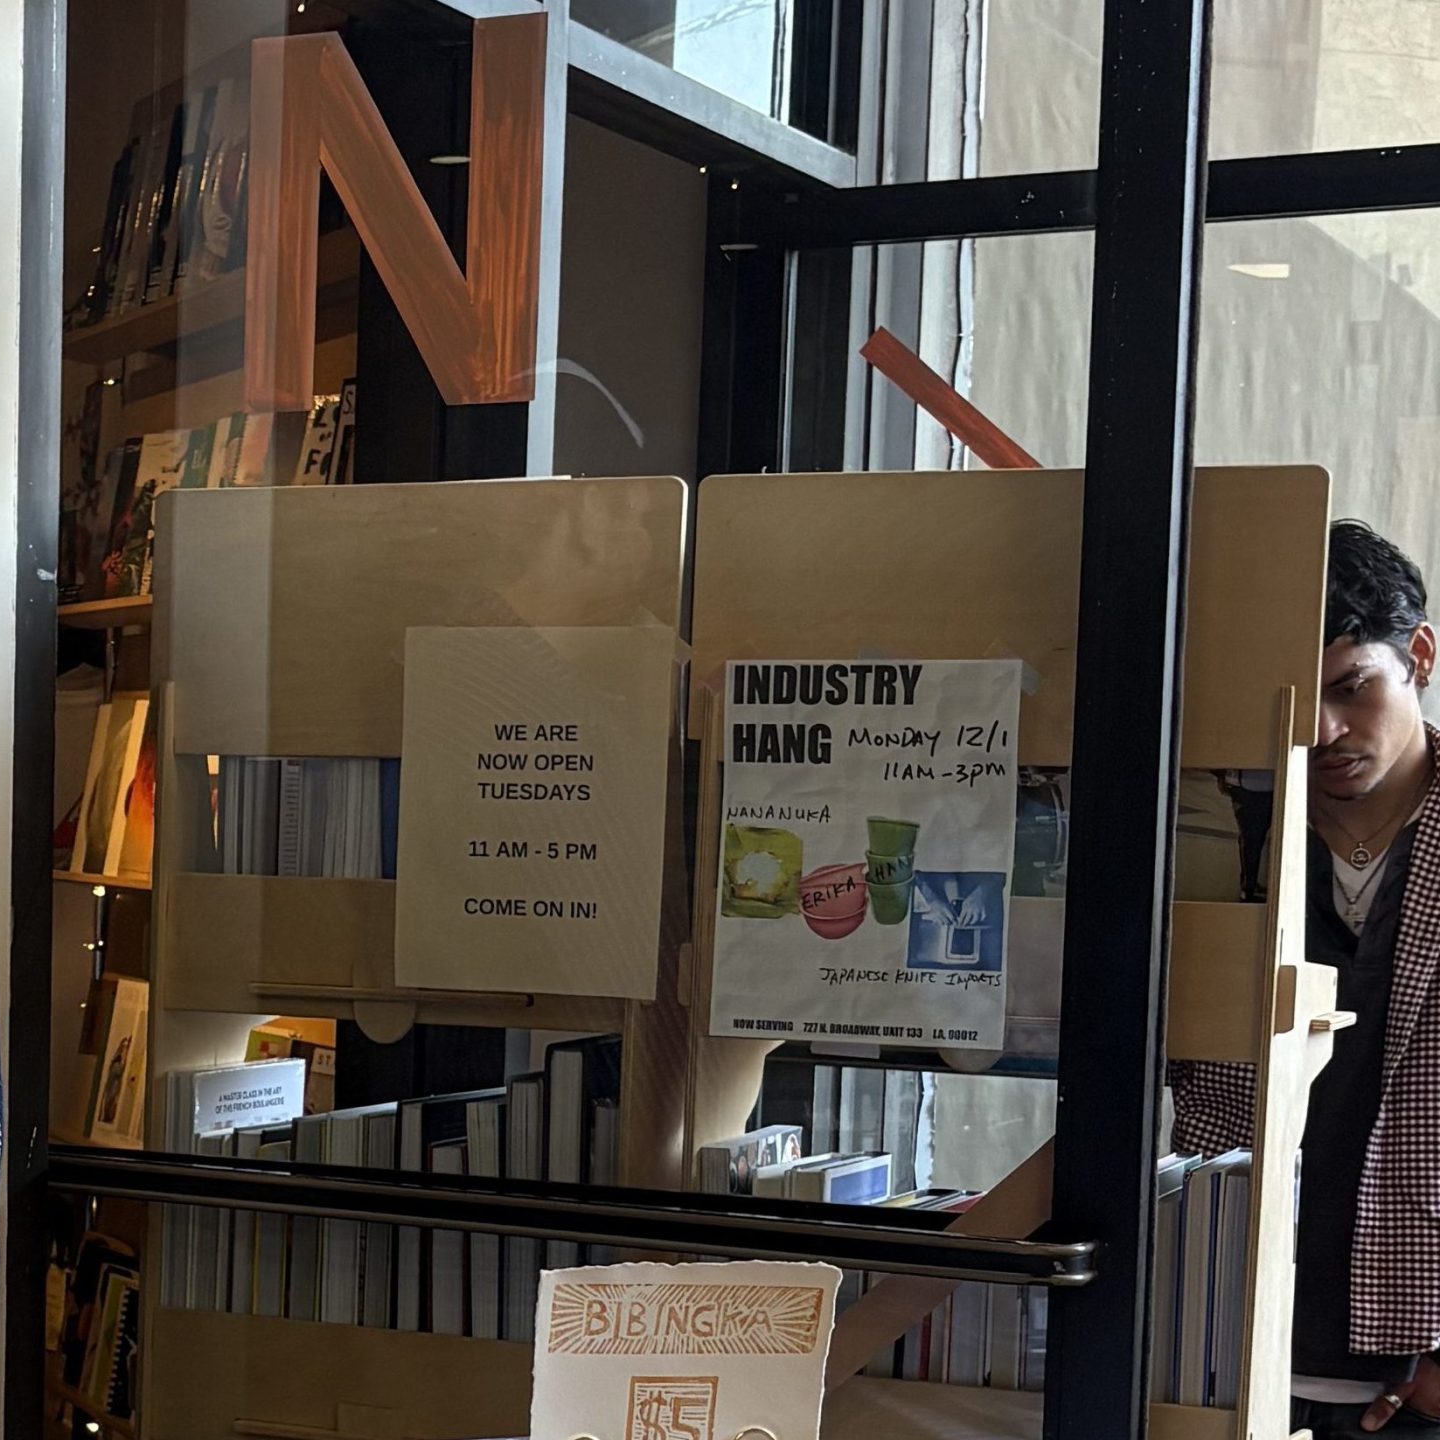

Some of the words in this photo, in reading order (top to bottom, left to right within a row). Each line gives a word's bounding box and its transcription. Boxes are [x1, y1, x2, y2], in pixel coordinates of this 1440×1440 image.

[733, 664, 923, 706] INDUSTRY
[494, 724, 527, 741] WE
[534, 724, 578, 742] ARE
[957, 720, 1008, 753] 12/1
[733, 723, 832, 765] HANG
[477, 753, 529, 771] NOW
[534, 754, 594, 772] OPEN
[477, 782, 591, 801] TUESDAYS
[727, 804, 831, 823] NANANUKA
[468, 840, 490, 857] 11
[496, 841, 528, 858] AM
[547, 842, 559, 859] 5
[566, 843, 597, 860] PM
[802, 876, 856, 909] ERIKA
[464, 898, 527, 917] COME
[533, 900, 564, 918] ON
[570, 901, 597, 919] IN!
[819, 967, 888, 985] JAPANESE
[895, 969, 937, 984] KNIFE
[733, 1018, 755, 1030] NOW
[756, 1018, 794, 1031] SERVING
[803, 1021, 818, 1033] 727
[906, 1027, 923, 1039] 133
[583, 1299, 773, 1338] BIBINGKA
